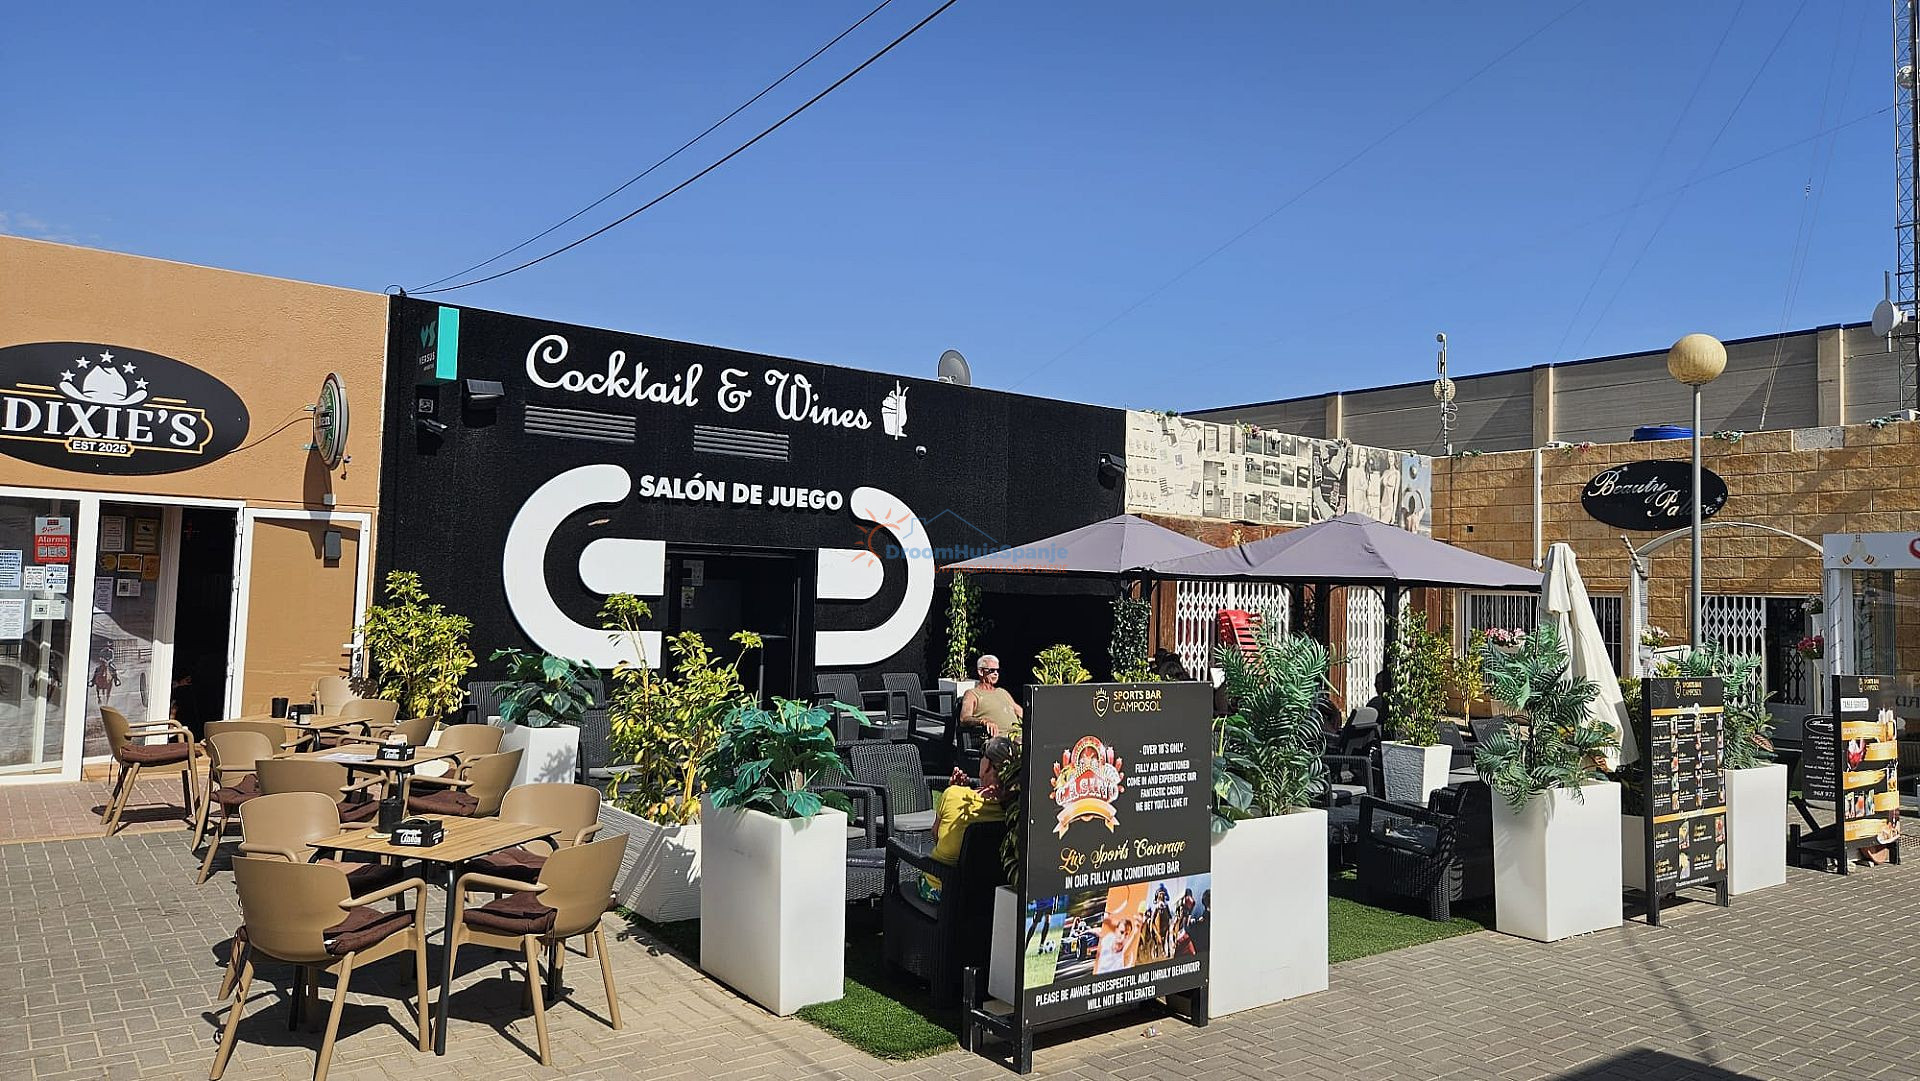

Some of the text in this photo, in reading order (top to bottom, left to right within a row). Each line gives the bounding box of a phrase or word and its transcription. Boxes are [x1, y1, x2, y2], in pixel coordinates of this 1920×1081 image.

[525, 334, 872, 430] Cocktail & Wines
[1, 396, 199, 447] DIXIE'S
[72, 440, 97, 451] EST
[639, 472, 843, 511] SALÓN DE JUEGO
[1587, 468, 1669, 504] Beauty
[38, 535, 68, 544] Alarma
[1113, 689, 1162, 700] SPORTS BAR
[1113, 700, 1162, 713] CAMPOSOL
[1142, 744, 1157, 755] OVER
[1169, 742, 1184, 753] ONLY
[1135, 762, 1149, 773] FULLY
[1126, 776, 1140, 786] COME
[1147, 775, 1158, 785] AND
[1158, 773, 1187, 784] EXPERIENCE
[1055, 777, 1119, 806] CASINO
[1140, 787, 1166, 798] FANTASTIC
[1144, 801, 1153, 811] BET
[1170, 798, 1182, 808] LOVE
[1058, 837, 1186, 874] Live Sports Coverage
[1065, 860, 1180, 889] IN OUR FULLY AIR CONDITIONED BAR
[1035, 961, 1201, 1007] PLEASE BE AWARE DISRESPECTFUL AND UNRULY BEHAVIOUR
[1087, 985, 1156, 1011] WILL NOT BE TOLERATED
